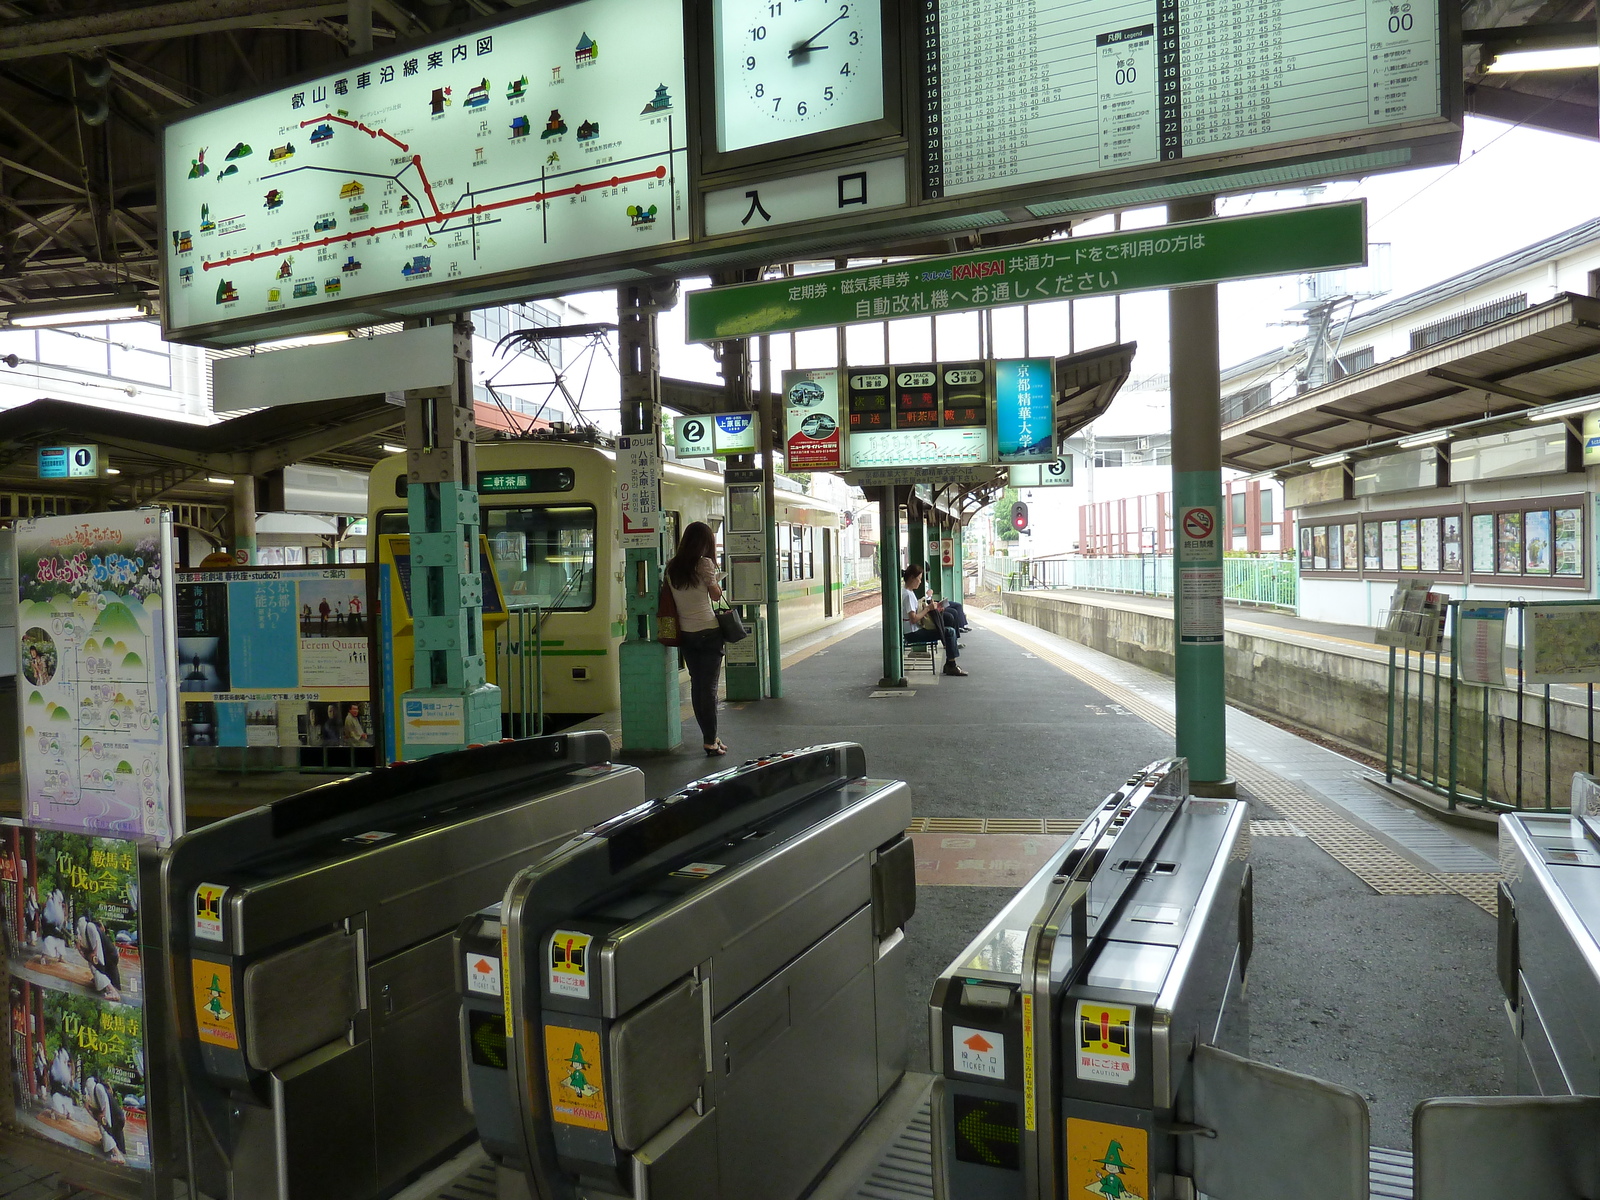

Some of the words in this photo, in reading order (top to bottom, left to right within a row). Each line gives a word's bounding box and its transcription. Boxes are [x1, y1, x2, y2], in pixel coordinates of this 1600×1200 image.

[768, 2, 782, 17] 11
[1162, 0, 1174, 9] 13
[840, 5, 849, 19] 2
[1162, 12, 1174, 23] 14
[925, 14, 935, 23] 10
[1388, 13, 1413, 33] 00
[751, 26, 766, 41] 10
[925, 26, 935, 35] 11
[1124, 30, 1143, 40] Legend
[1162, 26, 1175, 36] 15
[849, 31, 859, 45] 3
[926, 39, 936, 48] 12
[1163, 40, 1175, 50] 16
[926, 52, 936, 61] 13
[1163, 53, 1175, 64] 17
[746, 56, 756, 70] 9
[926, 64, 937, 73] 14
[291, 35, 493, 110] 叡山電車沿線案内図
[840, 62, 850, 77] 4
[1163, 67, 1176, 78] 18
[927, 77, 937, 86] 15
[1115, 67, 1137, 85] 00
[755, 84, 764, 97] 8
[1164, 81, 1176, 92] 19
[823, 86, 833, 101] 5
[927, 89, 938, 98] 16
[772, 98, 782, 112] 7
[1164, 95, 1176, 105] 20
[797, 101, 807, 115] 6
[927, 102, 938, 111] 17
[928, 114, 938, 123] 18
[1164, 109, 1176, 119] 21
[928, 127, 938, 136] 19
[1165, 122, 1177, 133] 22
[928, 139, 939, 149] 20
[1165, 136, 1177, 147] 23
[928, 152, 939, 161] 21
[1168, 151, 1175, 159] 0
[929, 164, 939, 174] 22
[432, 178, 454, 189] 三宅八幡
[647, 176, 676, 190] 出町柳
[929, 177, 940, 186] 23
[601, 186, 628, 198] 元田中
[931, 190, 938, 199] 0
[570, 195, 587, 205] 茶山
[741, 171, 868, 226] 入口
[468, 213, 492, 224] 修学院
[343, 241, 357, 250] 木野
[1008, 233, 1206, 274] 共通カードをご利用の方は
[855, 270, 1119, 319] 自動改札機へお通しください
[857, 377, 863, 388] 1
[904, 374, 913, 386] 2
[951, 371, 960, 383] 3
[854, 396, 886, 407] 次発
[902, 392, 933, 405] 先発
[1017, 364, 1032, 448] 京都精華大学
[850, 413, 880, 424] 回送
[898, 410, 938, 422] 二軒茶屋
[944, 409, 975, 421] 鞍馬
[688, 422, 700, 440] 2
[632, 438, 654, 446] のりば
[1050, 459, 1062, 473] 3
[483, 475, 527, 487] 二軒茶屋
[638, 450, 650, 514] 八瀬・大原・比叡山
[621, 483, 630, 511] のりば
[1184, 540, 1214, 548] 終日禁煙
[38, 551, 87, 583] 花しょうぶ
[90, 553, 144, 582] あじさい
[178, 571, 223, 582] 京都芸術劇場
[322, 569, 346, 579] ご案内
[554, 742, 560, 752] 3
[825, 756, 830, 767] 2
[92, 850, 132, 871] 鞍馬寺
[472, 973, 496, 984] 投入口
[552, 975, 586, 988] 扉にご注意
[473, 981, 488, 989] TICKET
[560, 984, 579, 992] CAUTION
[102, 1013, 138, 1036] 鞍馬寺
[961, 1051, 997, 1065] 投入口
[962, 1060, 987, 1072] TICKET
[988, 1065, 996, 1074] IN
[1081, 1057, 1130, 1072] 扉にご注意
[1091, 1069, 1120, 1078] CAUTION
[1025, 1045, 1033, 1127] かけこみはおやめください
